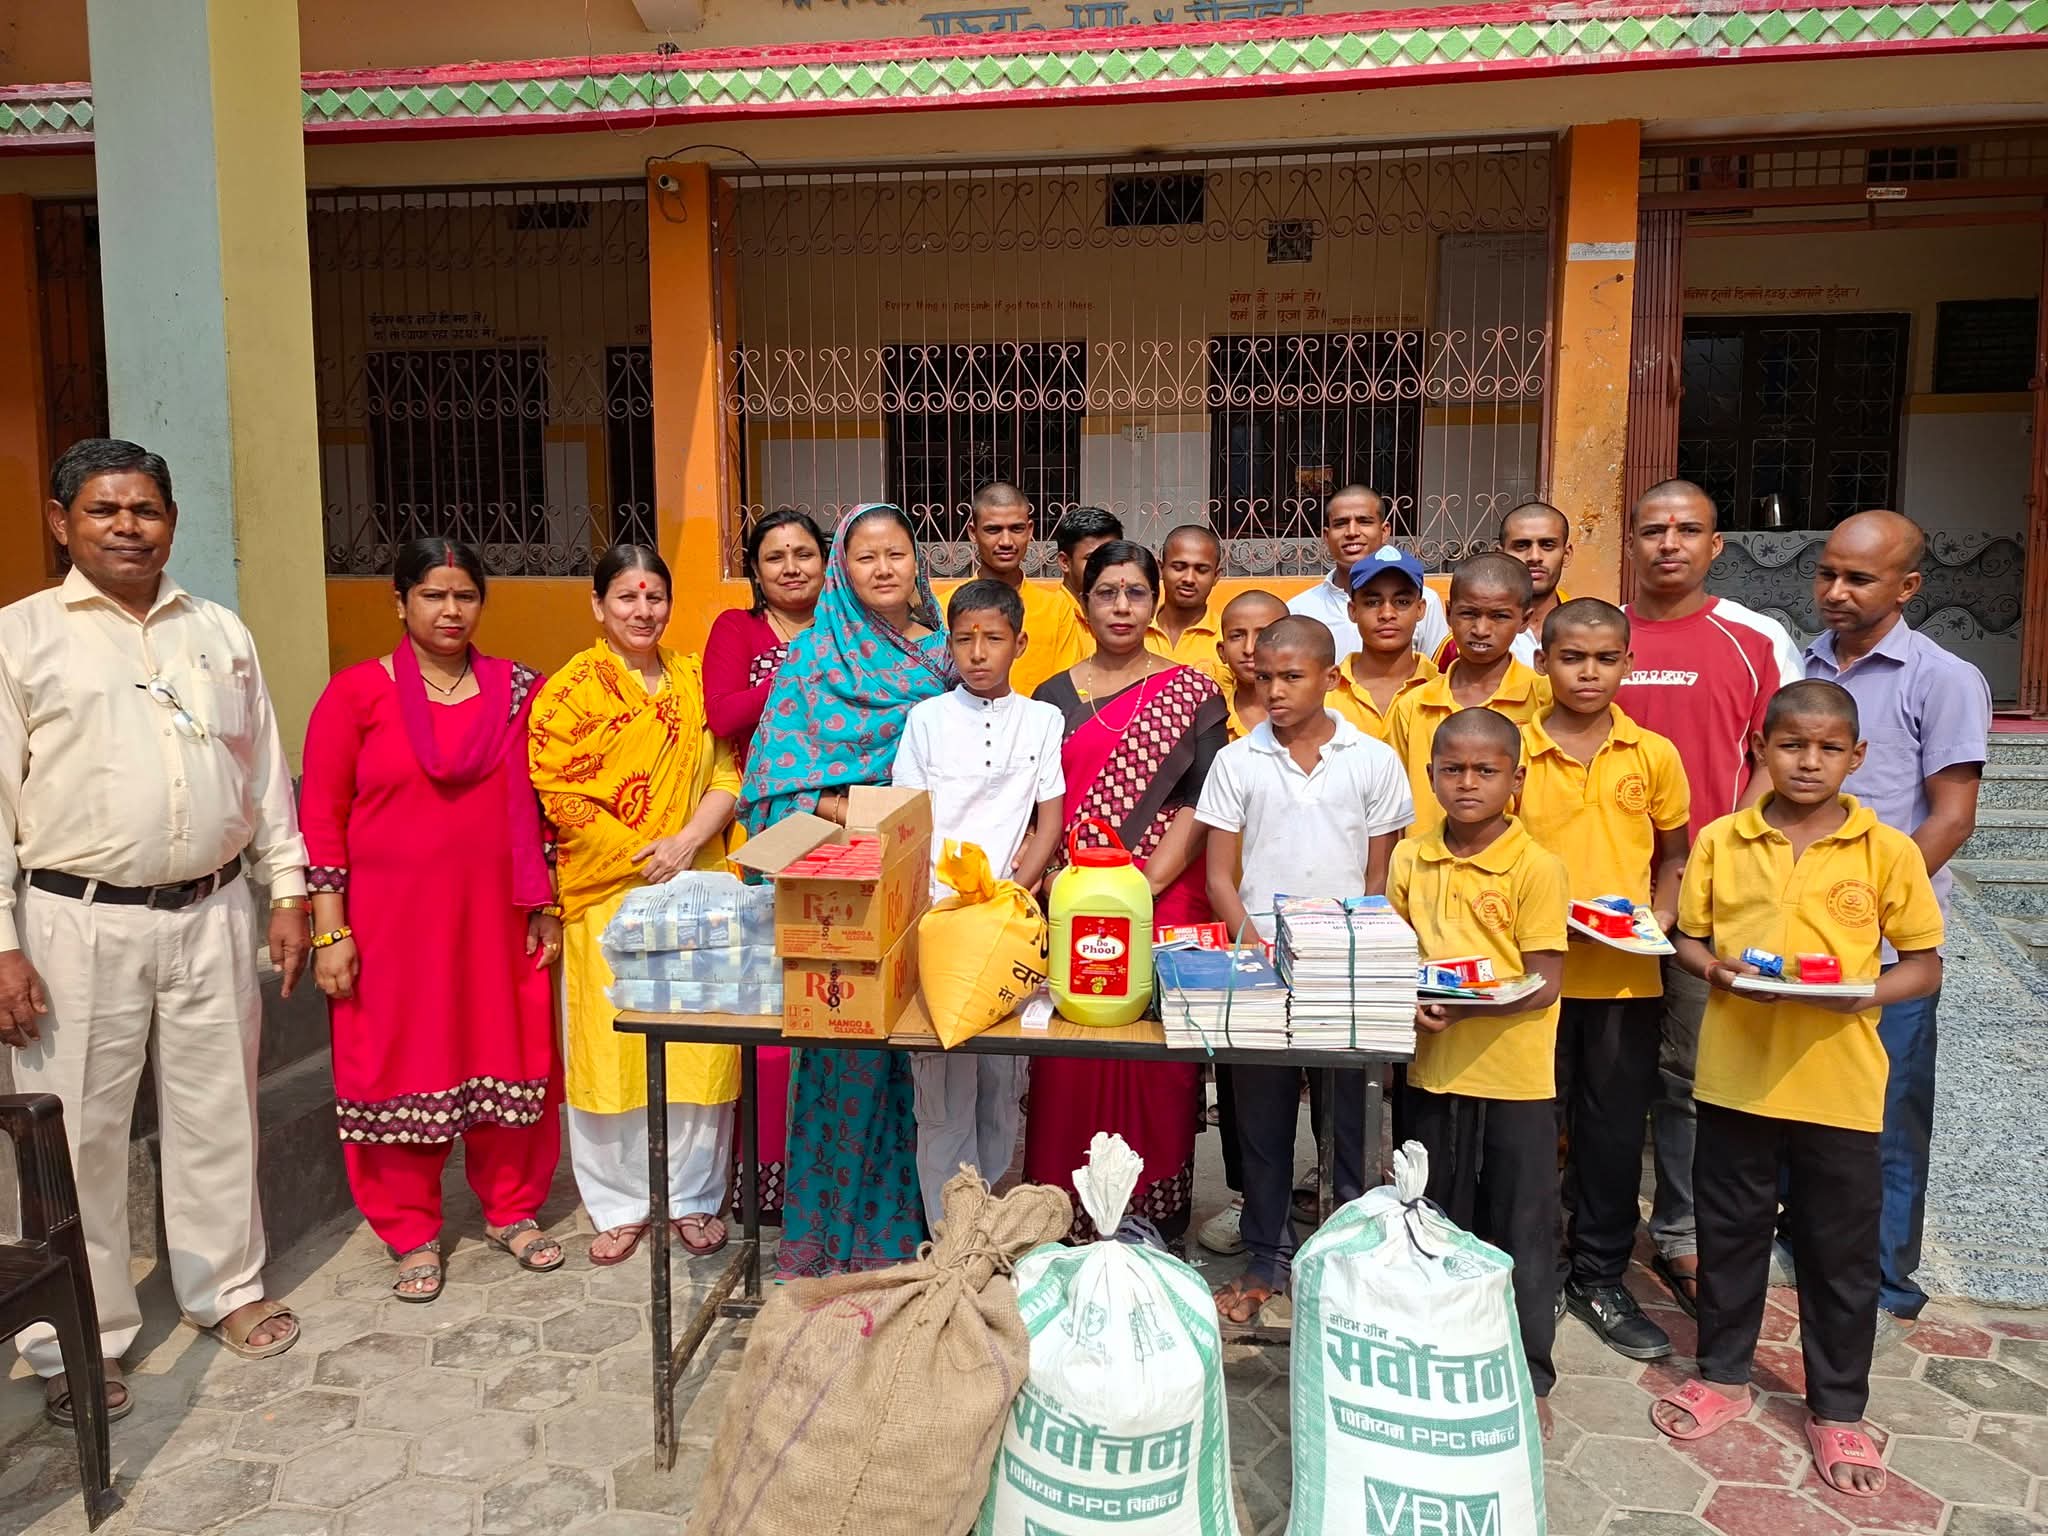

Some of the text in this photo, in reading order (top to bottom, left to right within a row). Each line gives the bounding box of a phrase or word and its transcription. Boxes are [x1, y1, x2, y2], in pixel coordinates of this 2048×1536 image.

[1096, 939, 1108, 947] Do
[1082, 945, 1116, 955] Phool
[829, 1019, 862, 1027] MANGO
[834, 1026, 875, 1035] GLUCOSE
[1412, 1426, 1466, 1449] PPC
[1068, 1492, 1121, 1516] PPC
